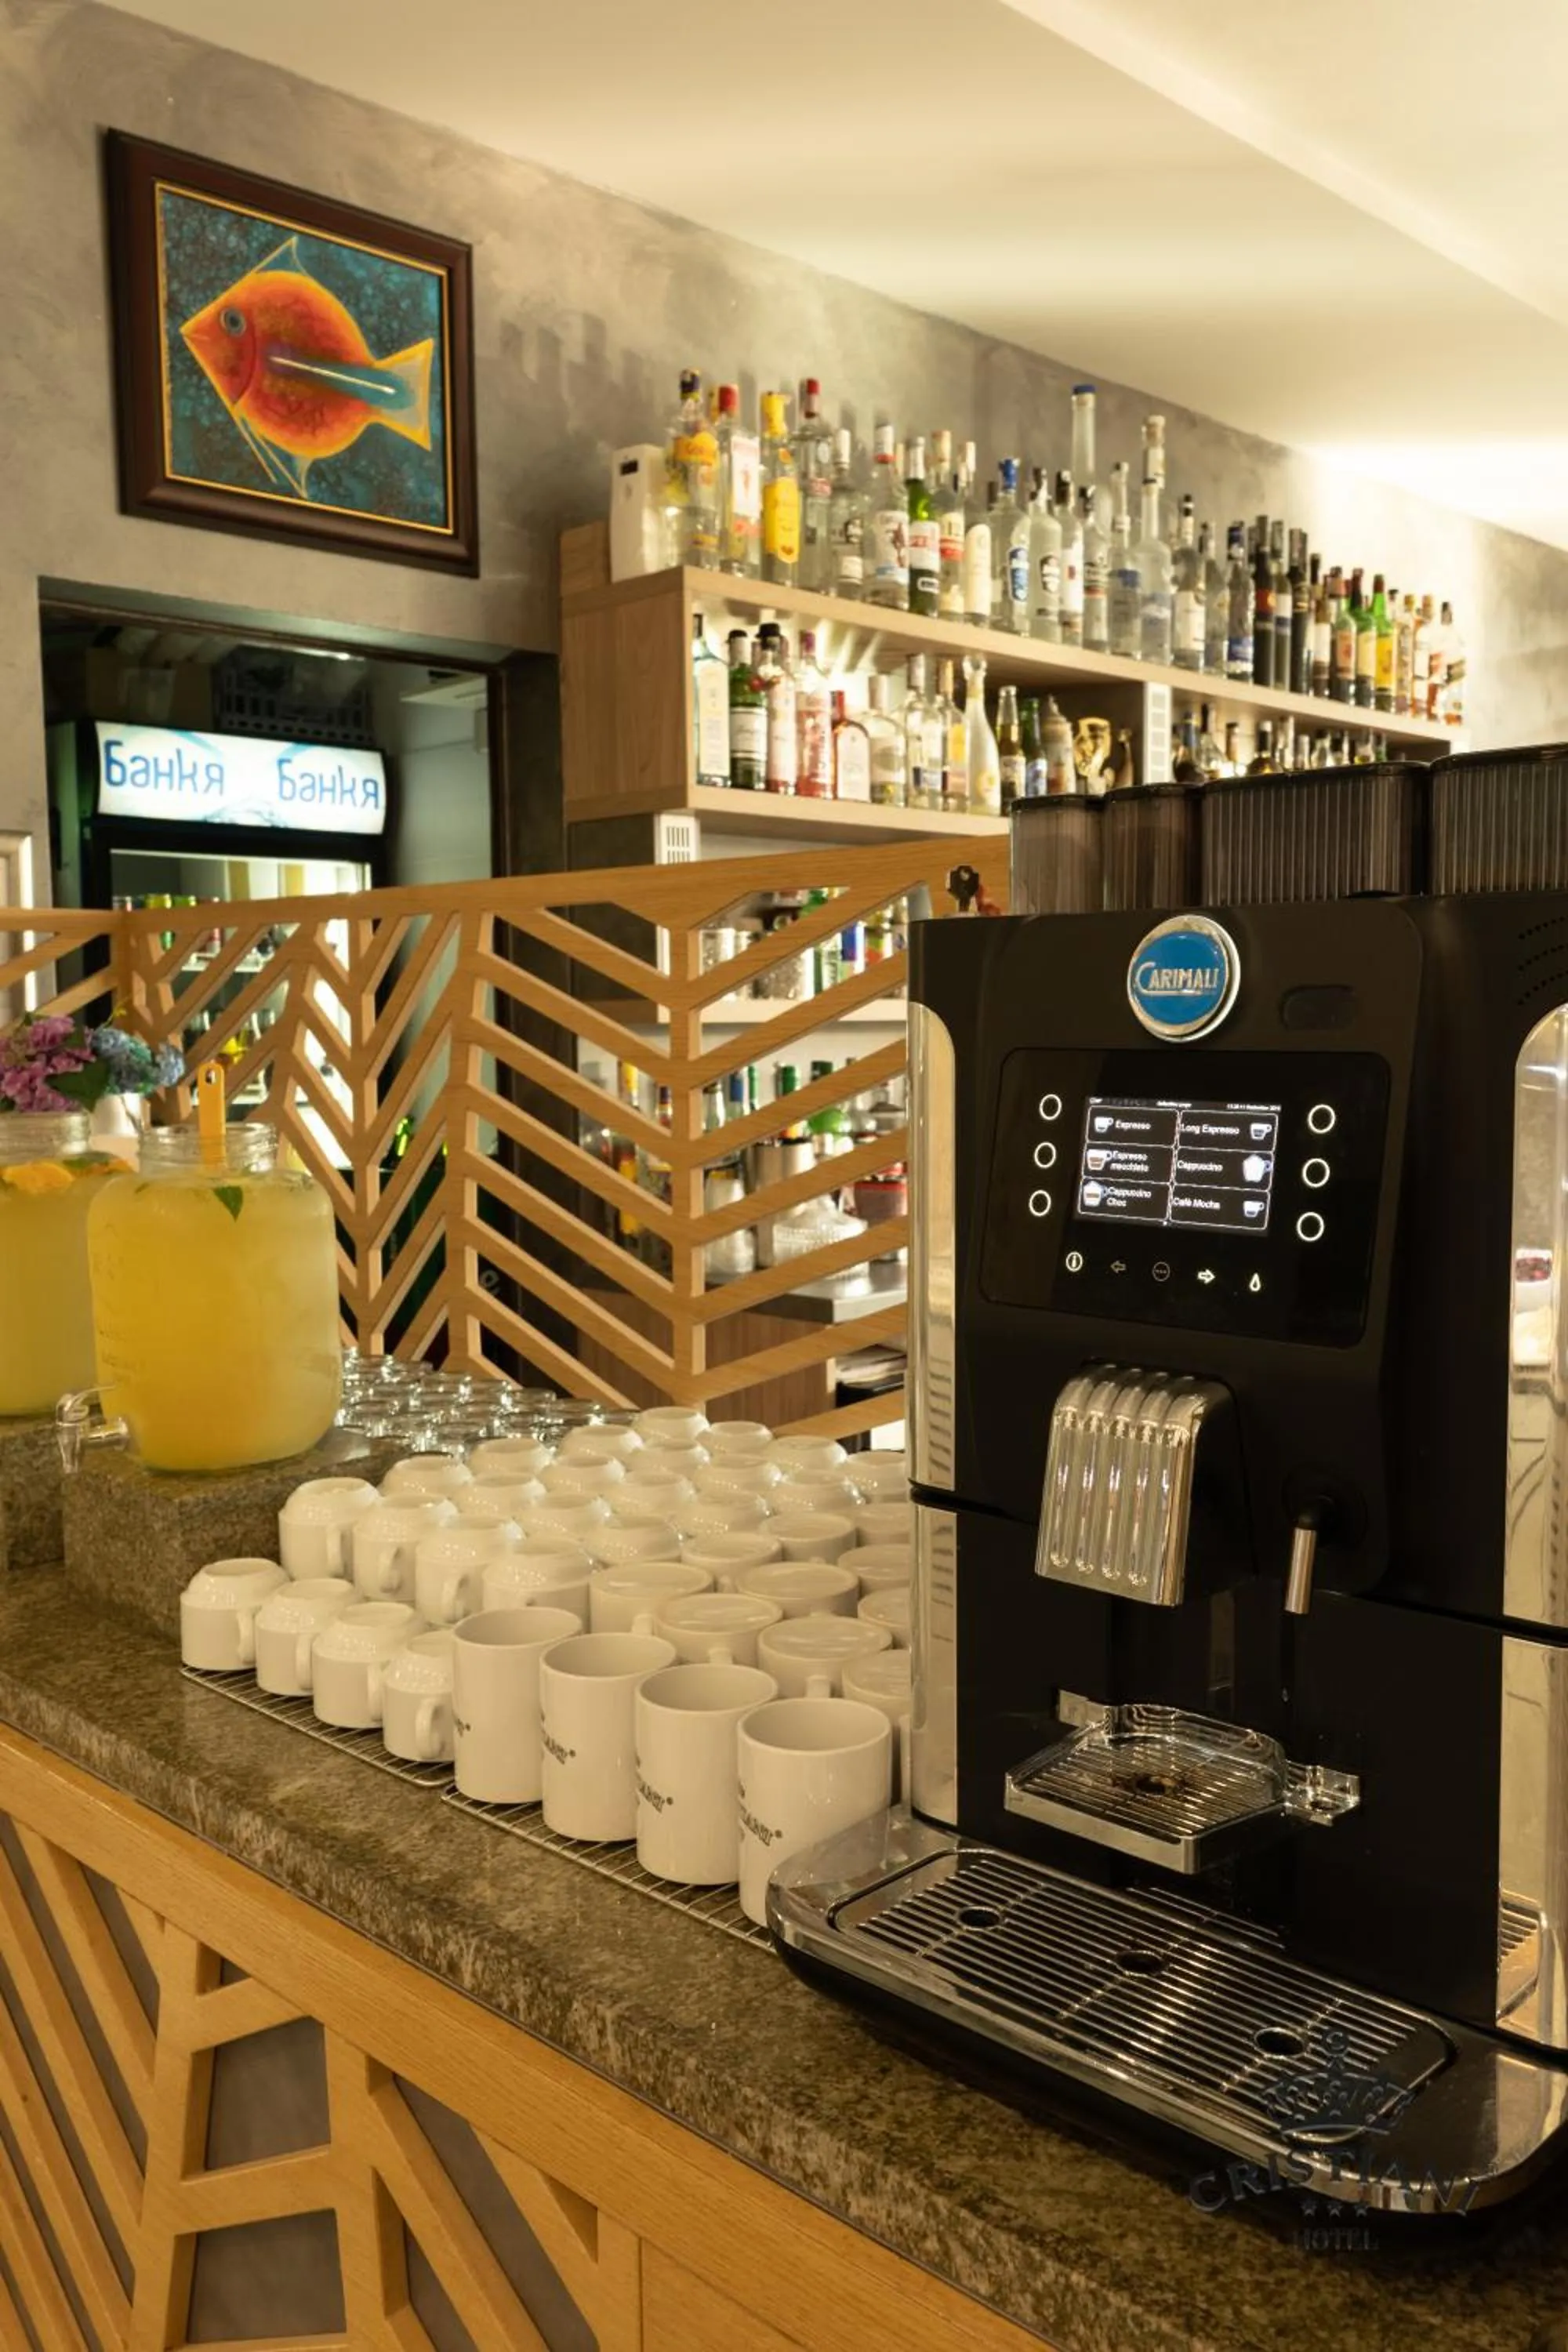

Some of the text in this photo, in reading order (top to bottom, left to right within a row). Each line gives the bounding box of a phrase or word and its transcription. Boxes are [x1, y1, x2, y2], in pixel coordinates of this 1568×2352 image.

[103, 739, 225, 796] Банкя
[276, 757, 380, 810] Банкя
[1135, 961, 1219, 996] CARIMALI
[1115, 1120, 1152, 1131] Espresso
[1181, 1123, 1240, 1135] Long Espresso
[1112, 1150, 1148, 1162] Espresso
[1177, 1160, 1223, 1173] Cappuccino
[1108, 1187, 1152, 1199] Cappuccino
[1106, 1197, 1127, 1207] Choc
[1193, 1199, 1221, 1210] Mocha
